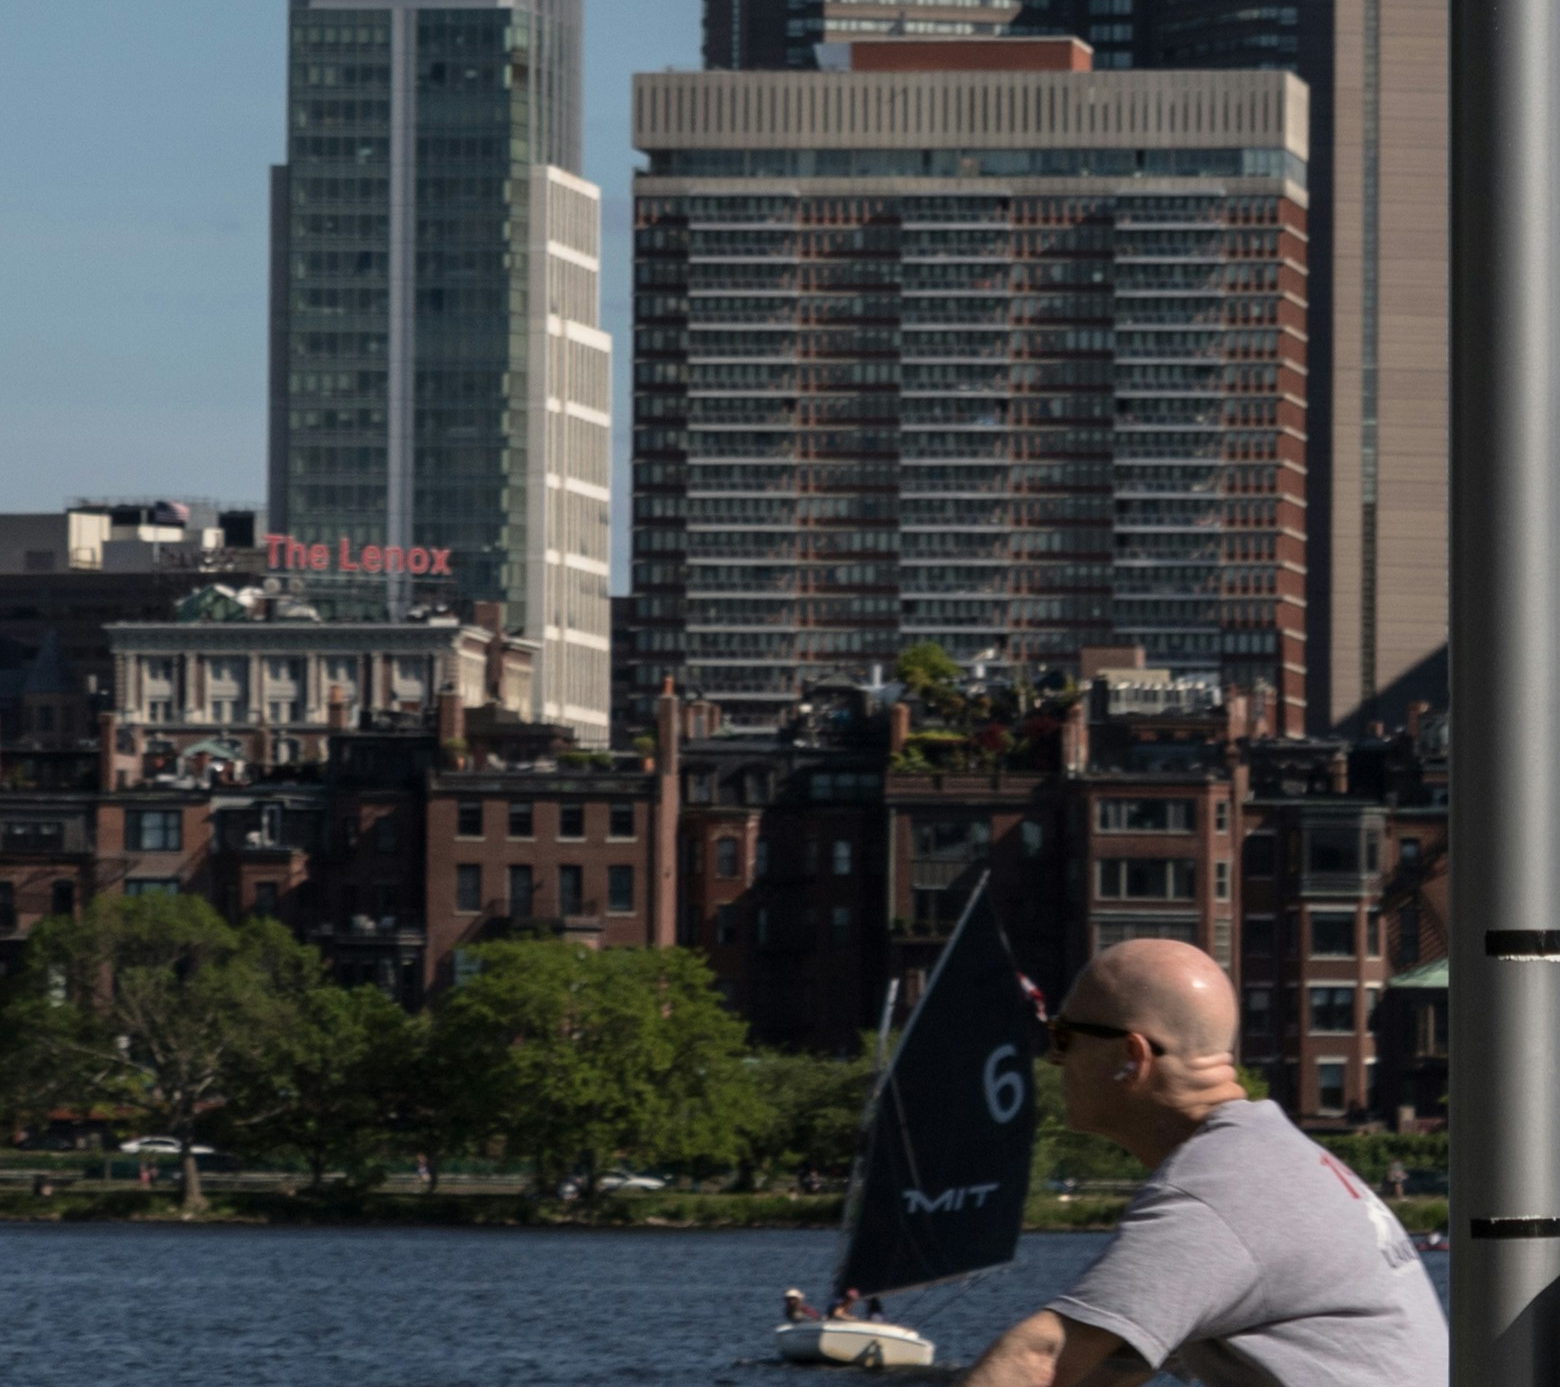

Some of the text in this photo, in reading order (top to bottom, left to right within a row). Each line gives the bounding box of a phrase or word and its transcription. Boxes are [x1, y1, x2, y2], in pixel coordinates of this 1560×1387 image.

[264, 533, 452, 575] The Lenox
[984, 1043, 1025, 1124] 6
[902, 1182, 1000, 1214] MIT
